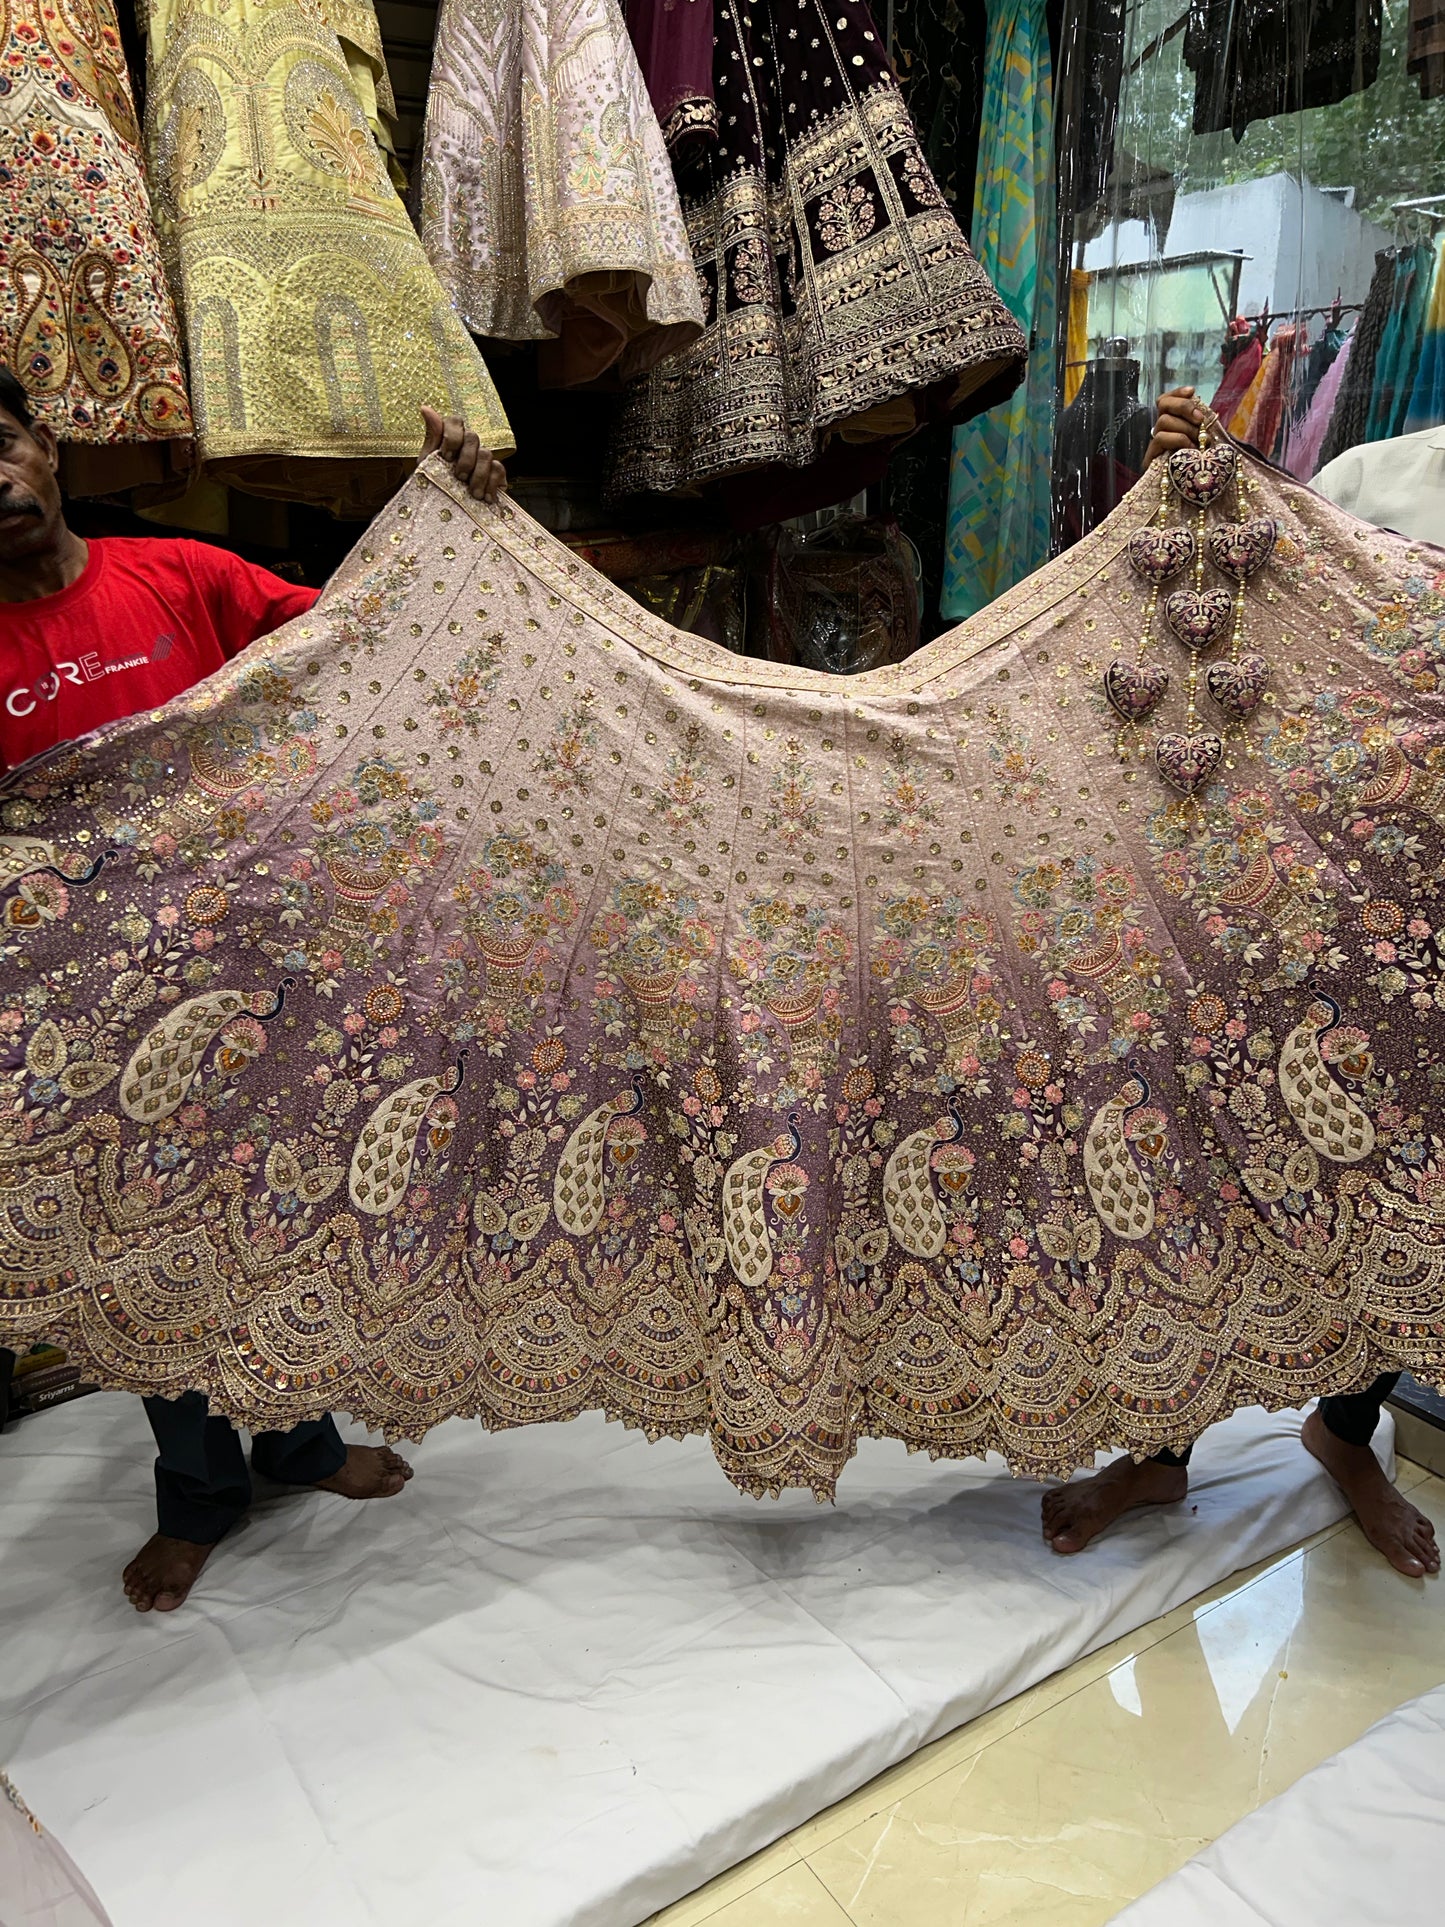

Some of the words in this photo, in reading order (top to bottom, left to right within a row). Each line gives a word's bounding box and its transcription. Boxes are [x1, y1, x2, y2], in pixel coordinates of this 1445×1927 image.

[5, 651, 106, 717] CORE
[104, 656, 149, 674] FRANKIE
[38, 1383, 75, 1402] Sriyarns
